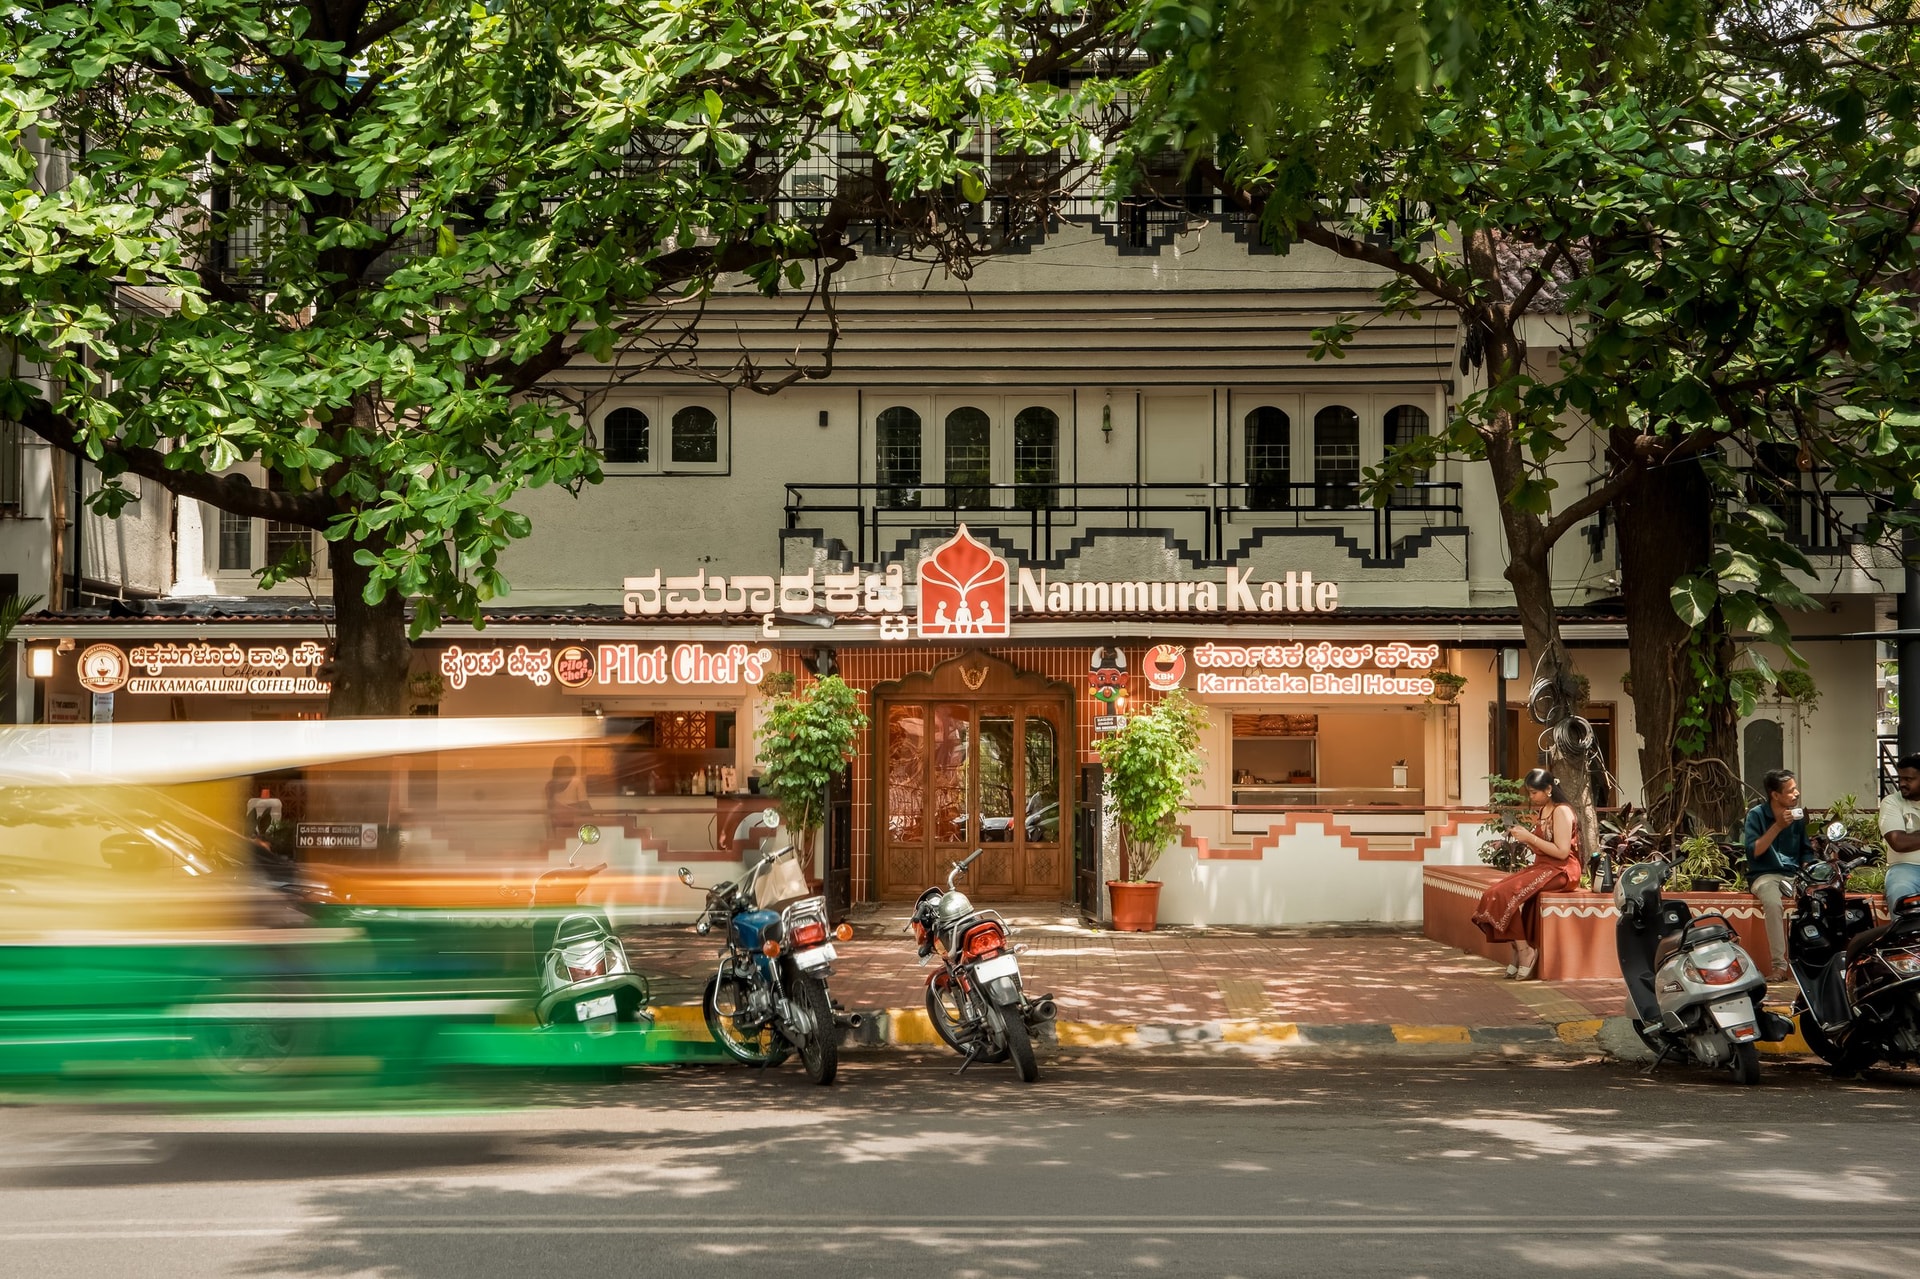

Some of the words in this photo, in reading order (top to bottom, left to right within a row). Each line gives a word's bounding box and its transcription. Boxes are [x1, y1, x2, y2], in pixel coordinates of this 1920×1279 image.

[1017, 567, 1219, 613] Nammura
[1226, 566, 1338, 612] Katte
[559, 659, 588, 672] Pilot
[600, 646, 666, 682] Pilot
[1195, 644, 1303, 666] ಕರ್ನಾಟಕ
[1376, 644, 1437, 667] ಹೌಸ್
[442, 647, 503, 687] ಪೈಲಟ್
[129, 679, 244, 692] CHIKKAMAGALURU
[250, 679, 293, 692] COFFEE
[1199, 674, 1307, 692] Karnataka
[1312, 674, 1360, 692] Bhel
[1366, 675, 1433, 693] House
[300, 837, 314, 846] NO
[316, 837, 360, 846] SMOKING
